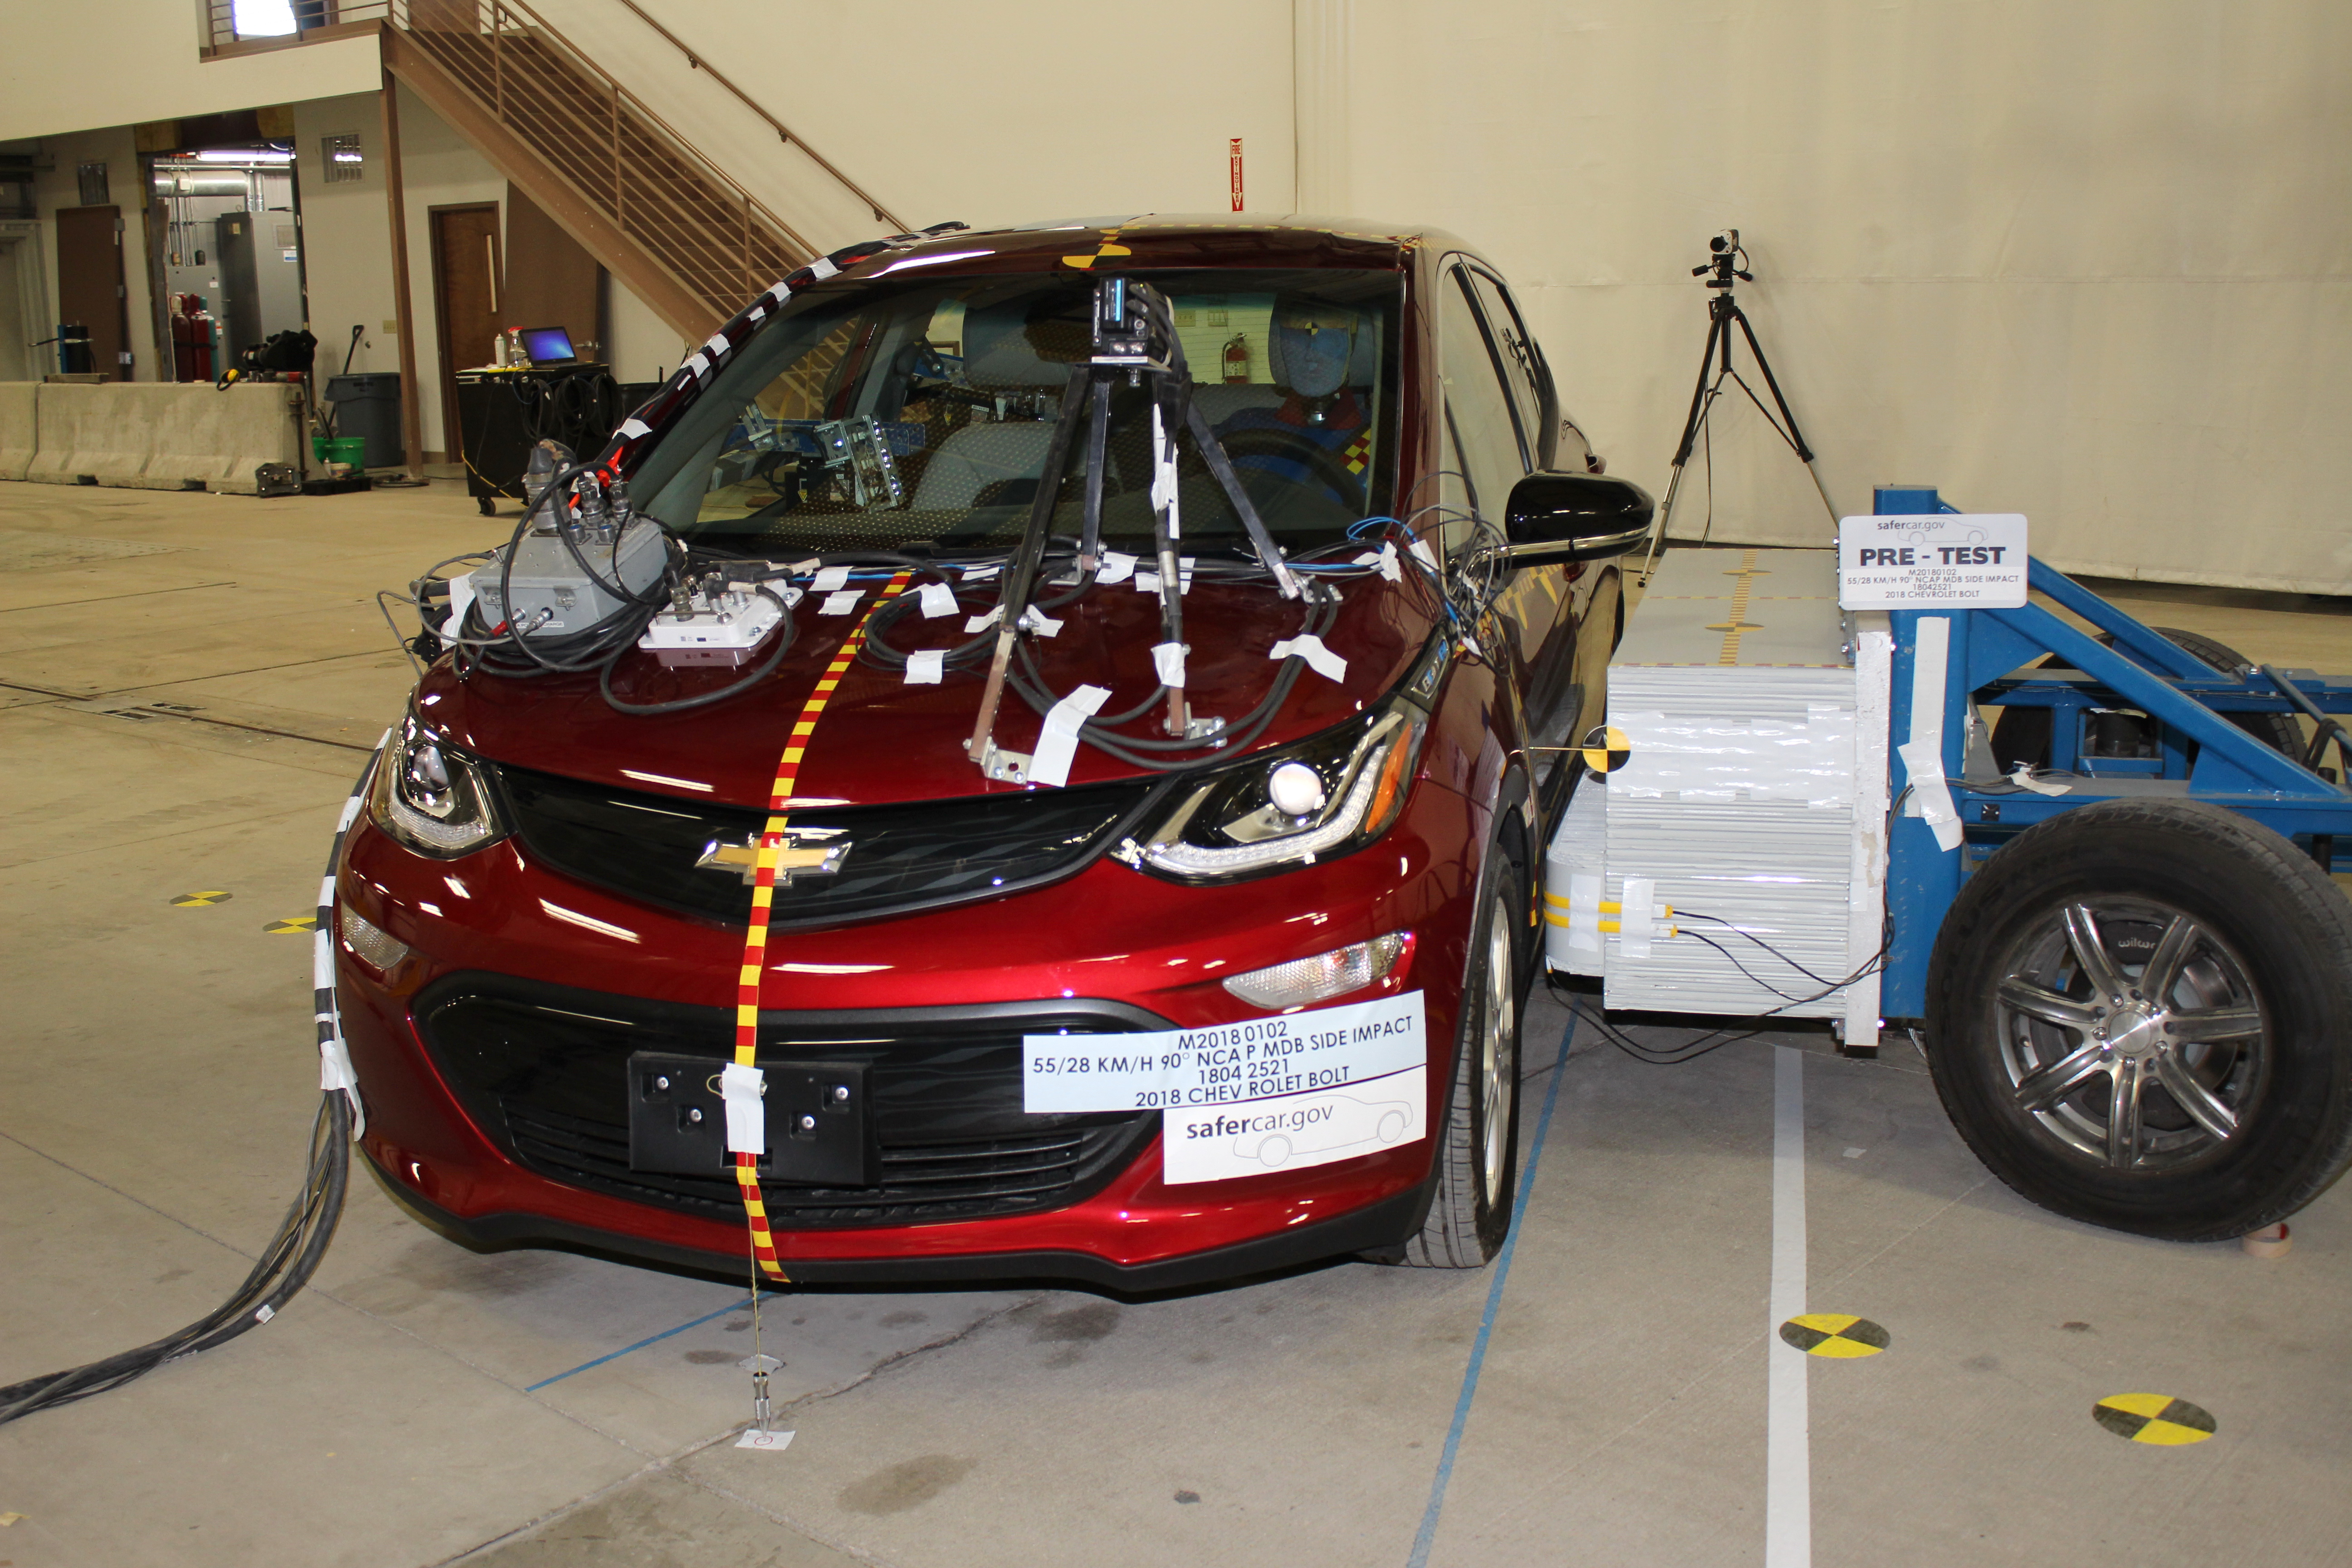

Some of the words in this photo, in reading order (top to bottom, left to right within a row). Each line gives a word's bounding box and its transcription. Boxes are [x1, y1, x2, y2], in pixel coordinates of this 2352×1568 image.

[1877, 520, 1945, 531] safercar.gov
[1860, 548, 1915, 566] PRE
[1938, 546, 2006, 565] TEST
[1847, 577, 1871, 585] 55/28
[1873, 576, 1897, 584] KM/H
[1033, 1057, 1090, 1076] 55/28
[1098, 1056, 1152, 1074] KM/H
[1264, 1037, 1304, 1058] MDB
[1310, 1030, 1348, 1051] SIDE
[1353, 1015, 1412, 1044] IMPACT
[1135, 1089, 1181, 1107] 2018
[1309, 1065, 1350, 1087] BOLT
[1186, 1105, 1333, 1139] safercar.gov
